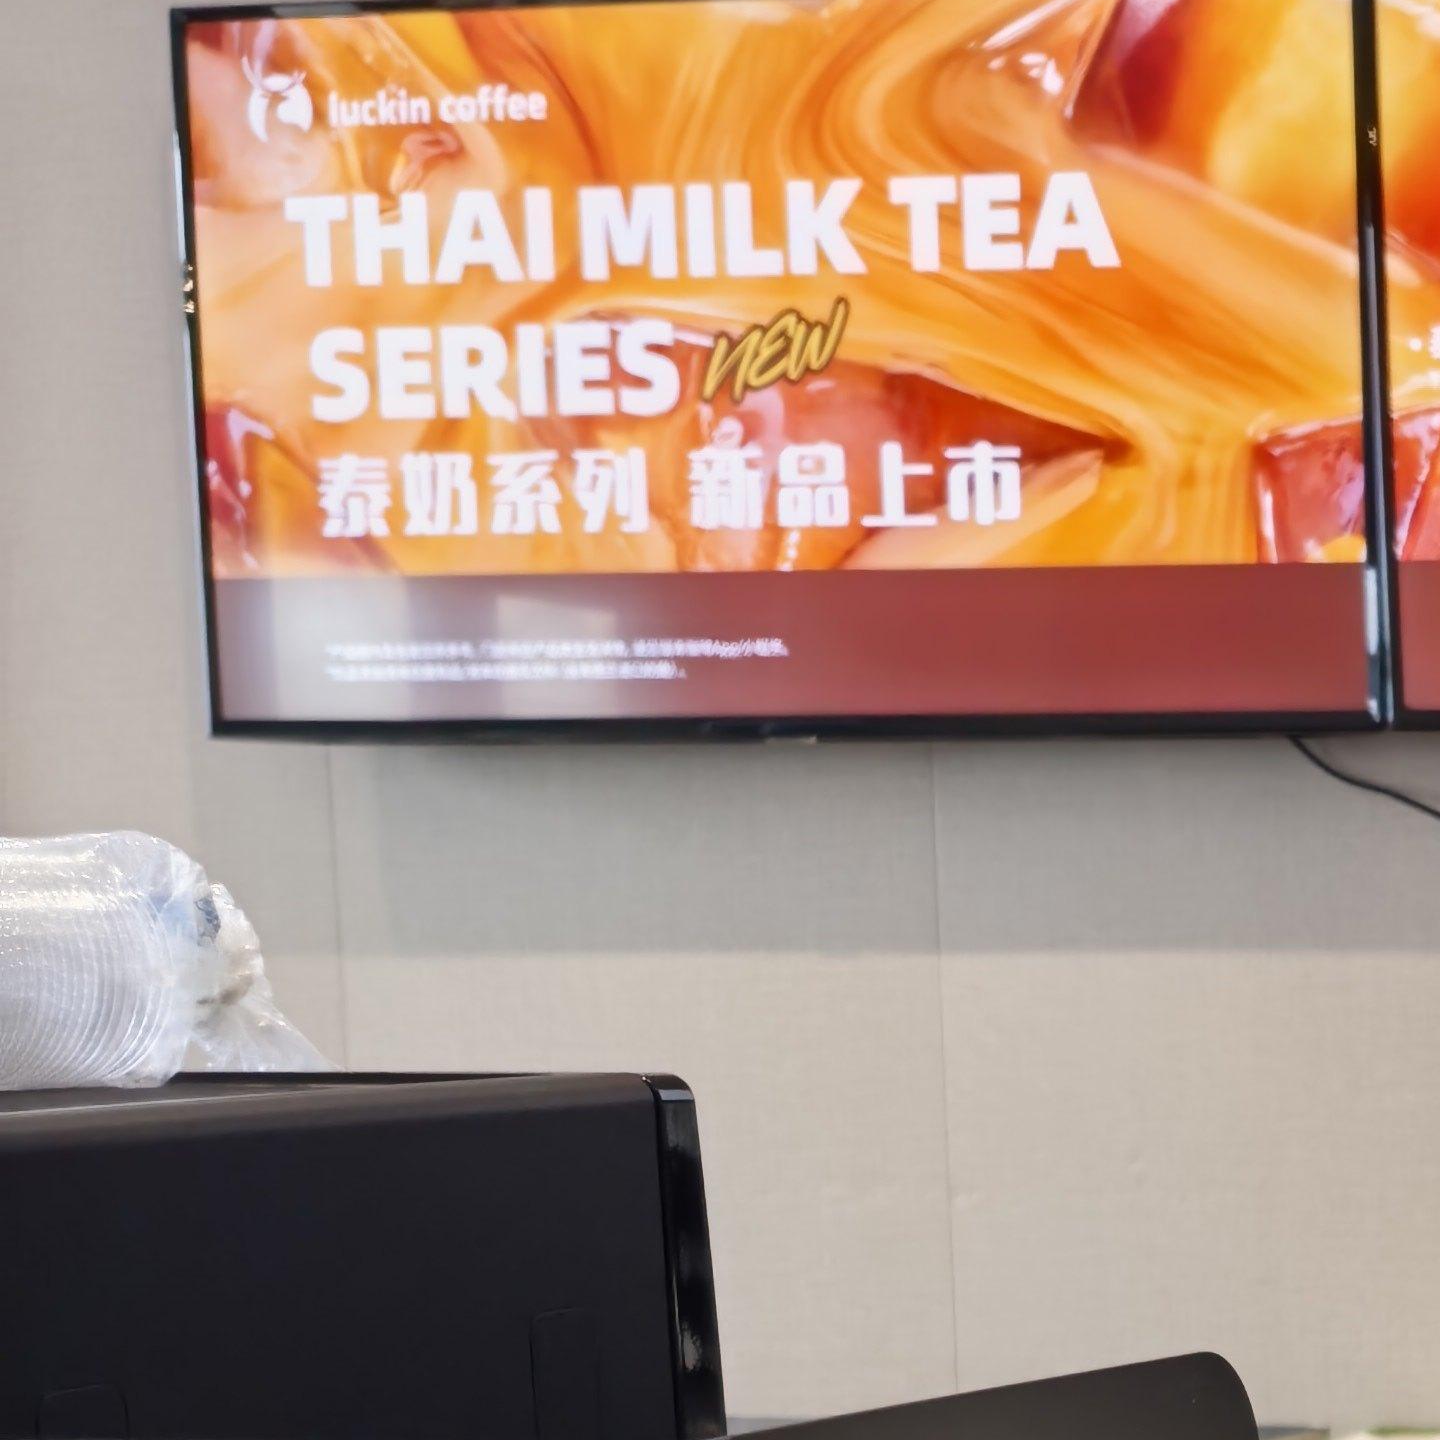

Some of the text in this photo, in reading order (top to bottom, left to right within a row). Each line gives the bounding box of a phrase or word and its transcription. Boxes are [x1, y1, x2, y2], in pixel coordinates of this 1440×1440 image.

[328, 83, 548, 129] luckin coffee
[285, 168, 1122, 288] THAI MILK TEA
[309, 318, 683, 423] SERIES
[317, 440, 1024, 538] 泰奶系列 新品上市
